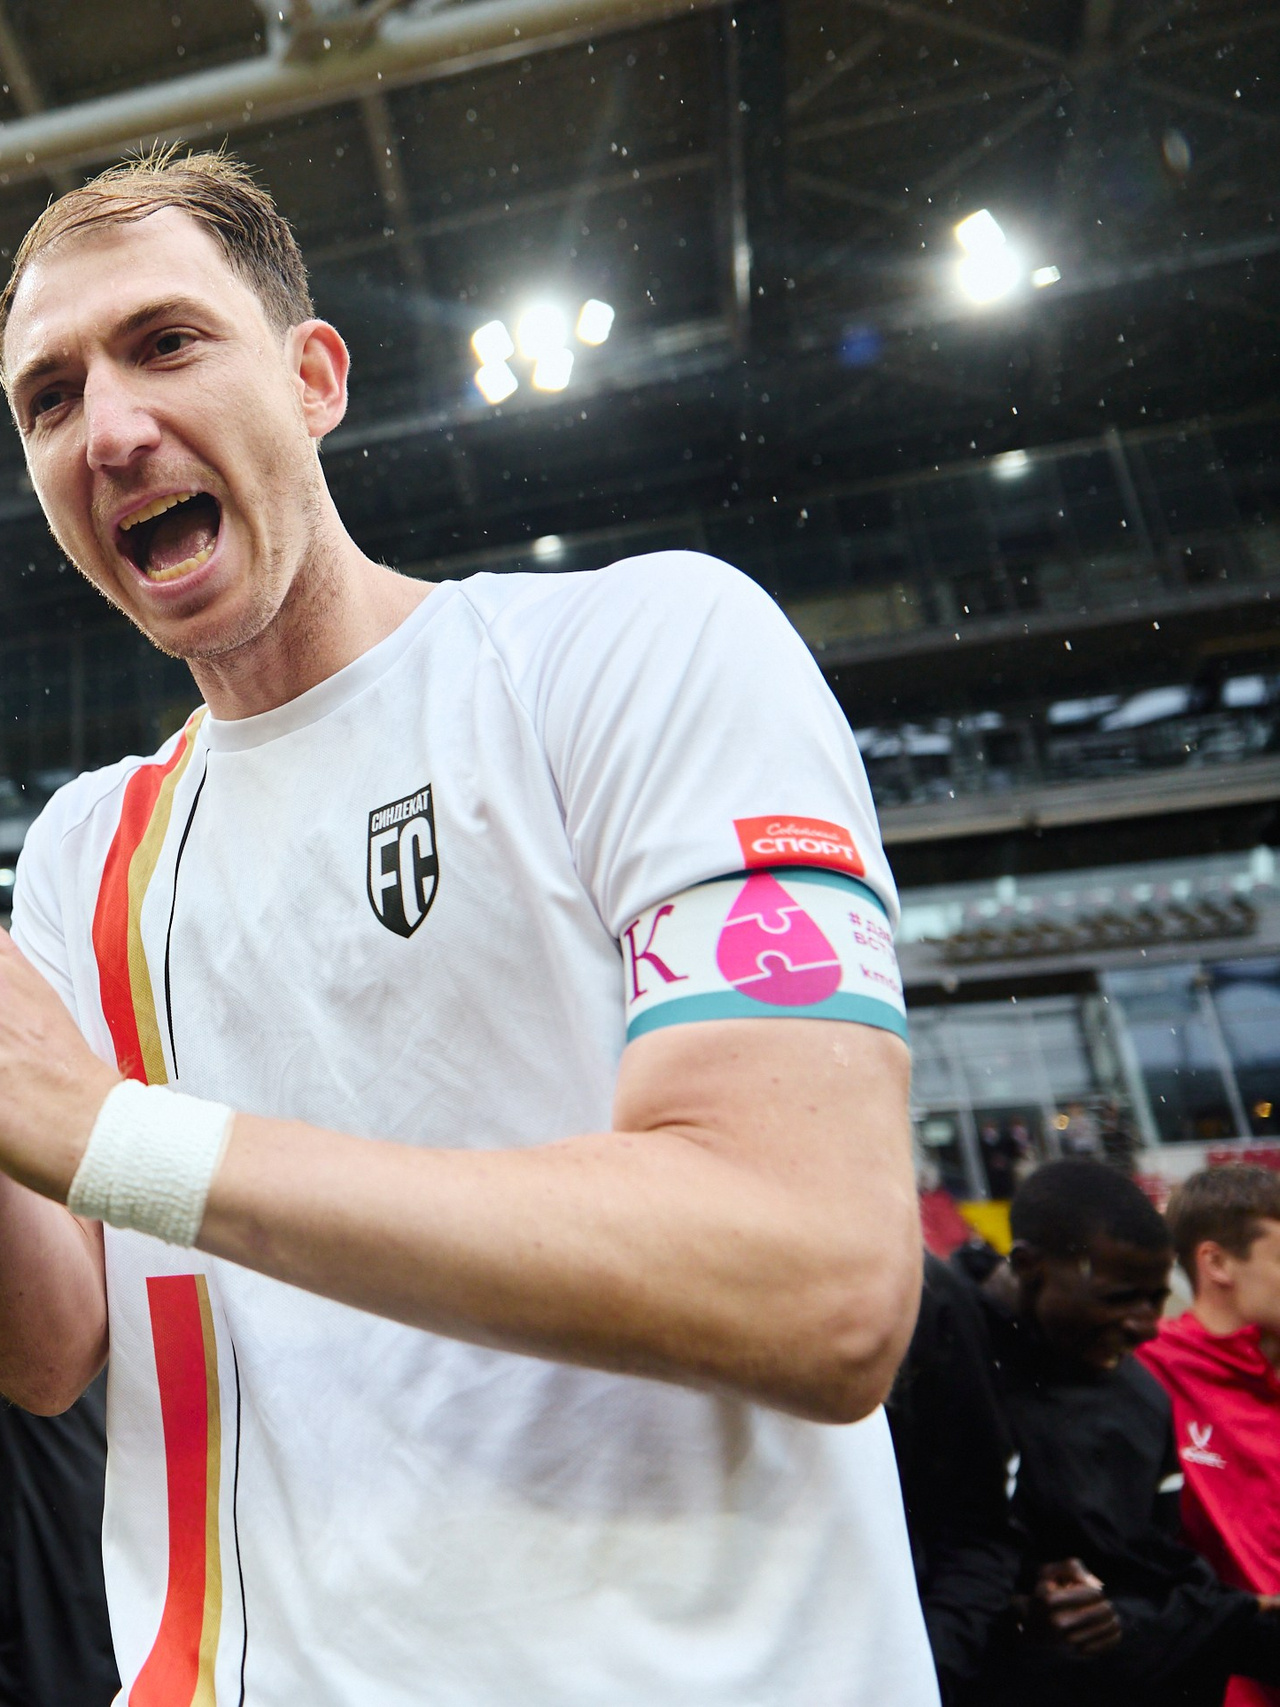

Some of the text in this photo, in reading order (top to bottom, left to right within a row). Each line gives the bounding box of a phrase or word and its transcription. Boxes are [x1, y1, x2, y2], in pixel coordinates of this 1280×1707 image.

[370, 789, 430, 833] СИНДЕКАТ
[751, 837, 855, 861] СПОРТ
[370, 816, 435, 928] FC
